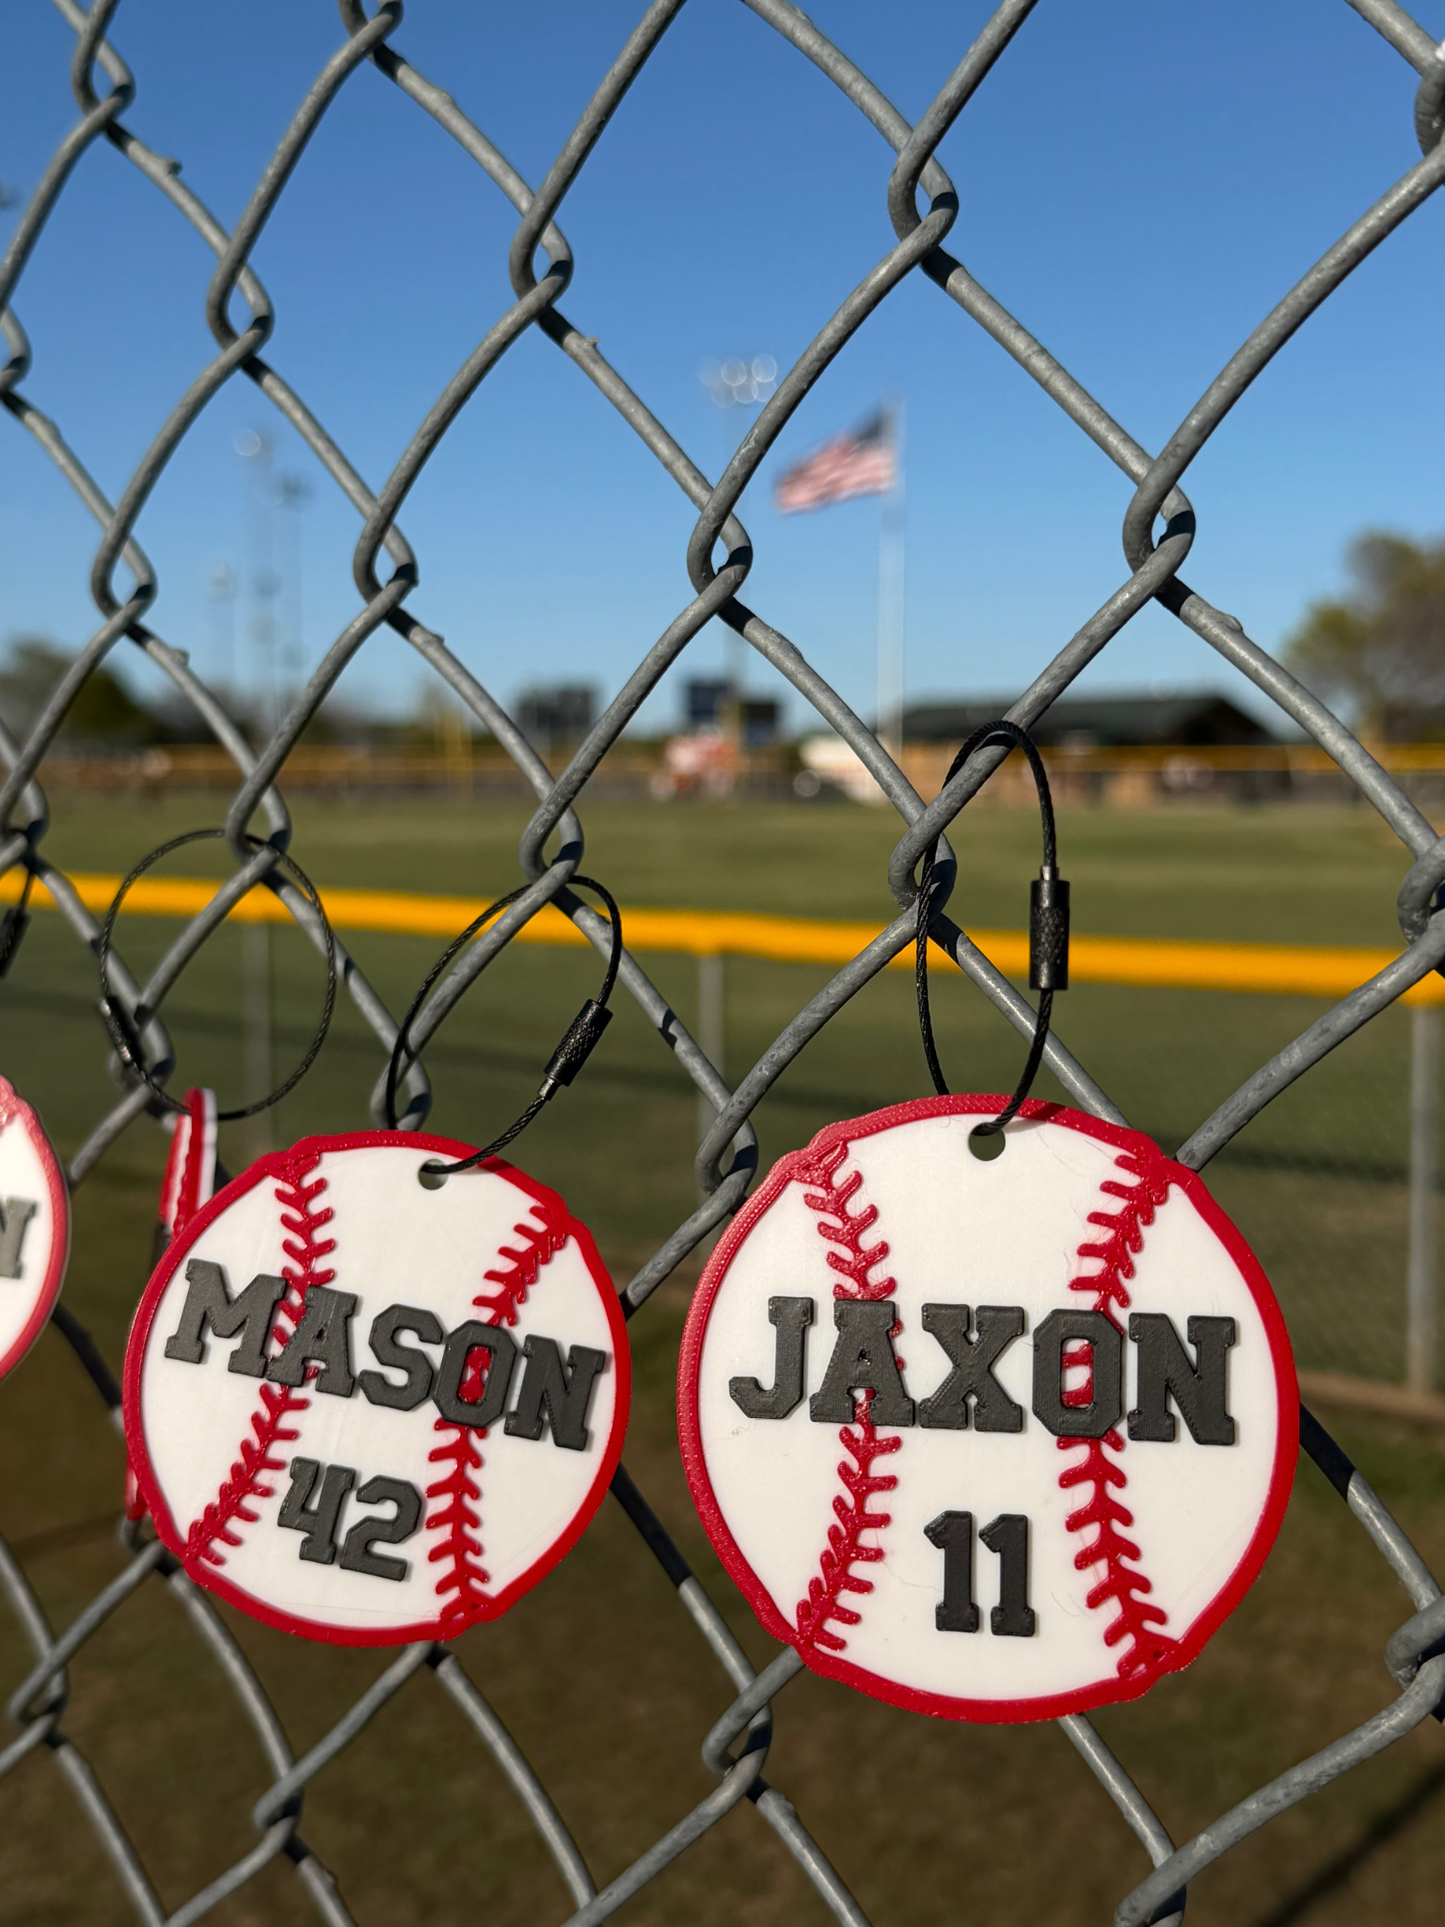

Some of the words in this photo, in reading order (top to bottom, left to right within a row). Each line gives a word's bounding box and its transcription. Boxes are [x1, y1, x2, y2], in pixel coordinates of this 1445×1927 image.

[164, 1258, 606, 1451] MASON
[728, 1296, 1236, 1446] JAXON
[277, 1457, 422, 1581] 42
[923, 1510, 1036, 1637] 11
